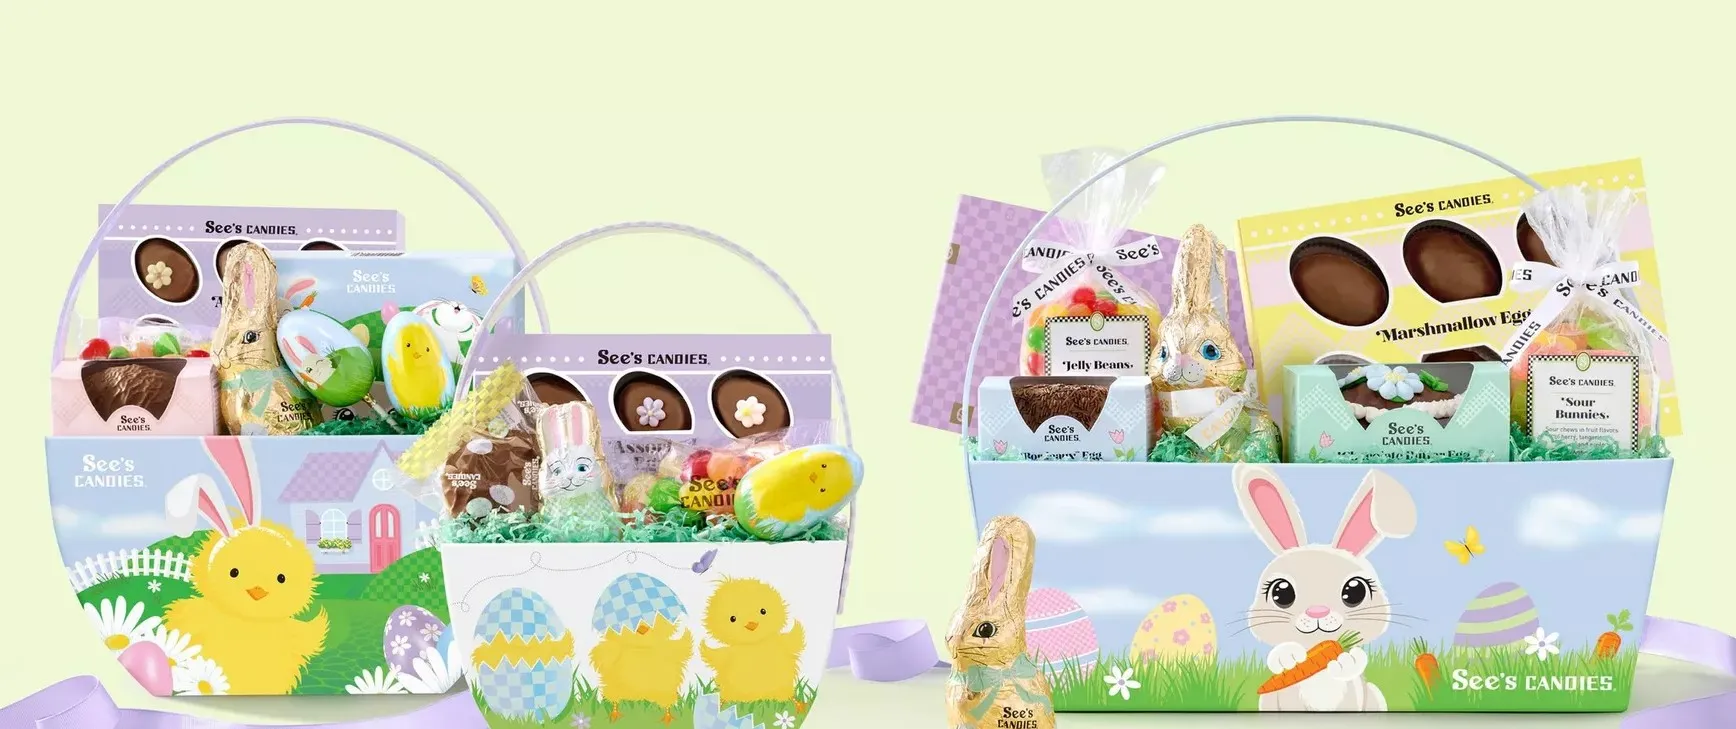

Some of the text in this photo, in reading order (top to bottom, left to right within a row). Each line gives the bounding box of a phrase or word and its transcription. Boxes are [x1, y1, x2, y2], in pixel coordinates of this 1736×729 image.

[1395, 193, 1494, 218] See's CANDIES
[205, 220, 298, 236] See's CANDIES
[1116, 243, 1160, 261] See's
[352, 269, 390, 283] See's
[1034, 257, 1086, 301] CANDIES
[346, 284, 397, 294] CANDIES
[1376, 316, 1498, 342] Marshmallow
[1065, 336, 1130, 346] See's CANDIES
[597, 349, 711, 366] See's CANDIES
[1549, 375, 1616, 387] See's CANDIES
[280, 400, 308, 413] See's
[120, 414, 146, 425] See's
[276, 411, 313, 423] CANDIES
[116, 424, 153, 432] CANDIES
[1048, 424, 1075, 435] See's
[1388, 421, 1425, 436] See's
[1043, 434, 1082, 442] CANDIES
[1381, 435, 1433, 446] CANDIES
[82, 453, 135, 472] See's
[523, 461, 533, 486] See's
[74, 474, 148, 488] CANDIES
[1452, 668, 1617, 692] See's CANDIES
[1002, 706, 1034, 719] See's
